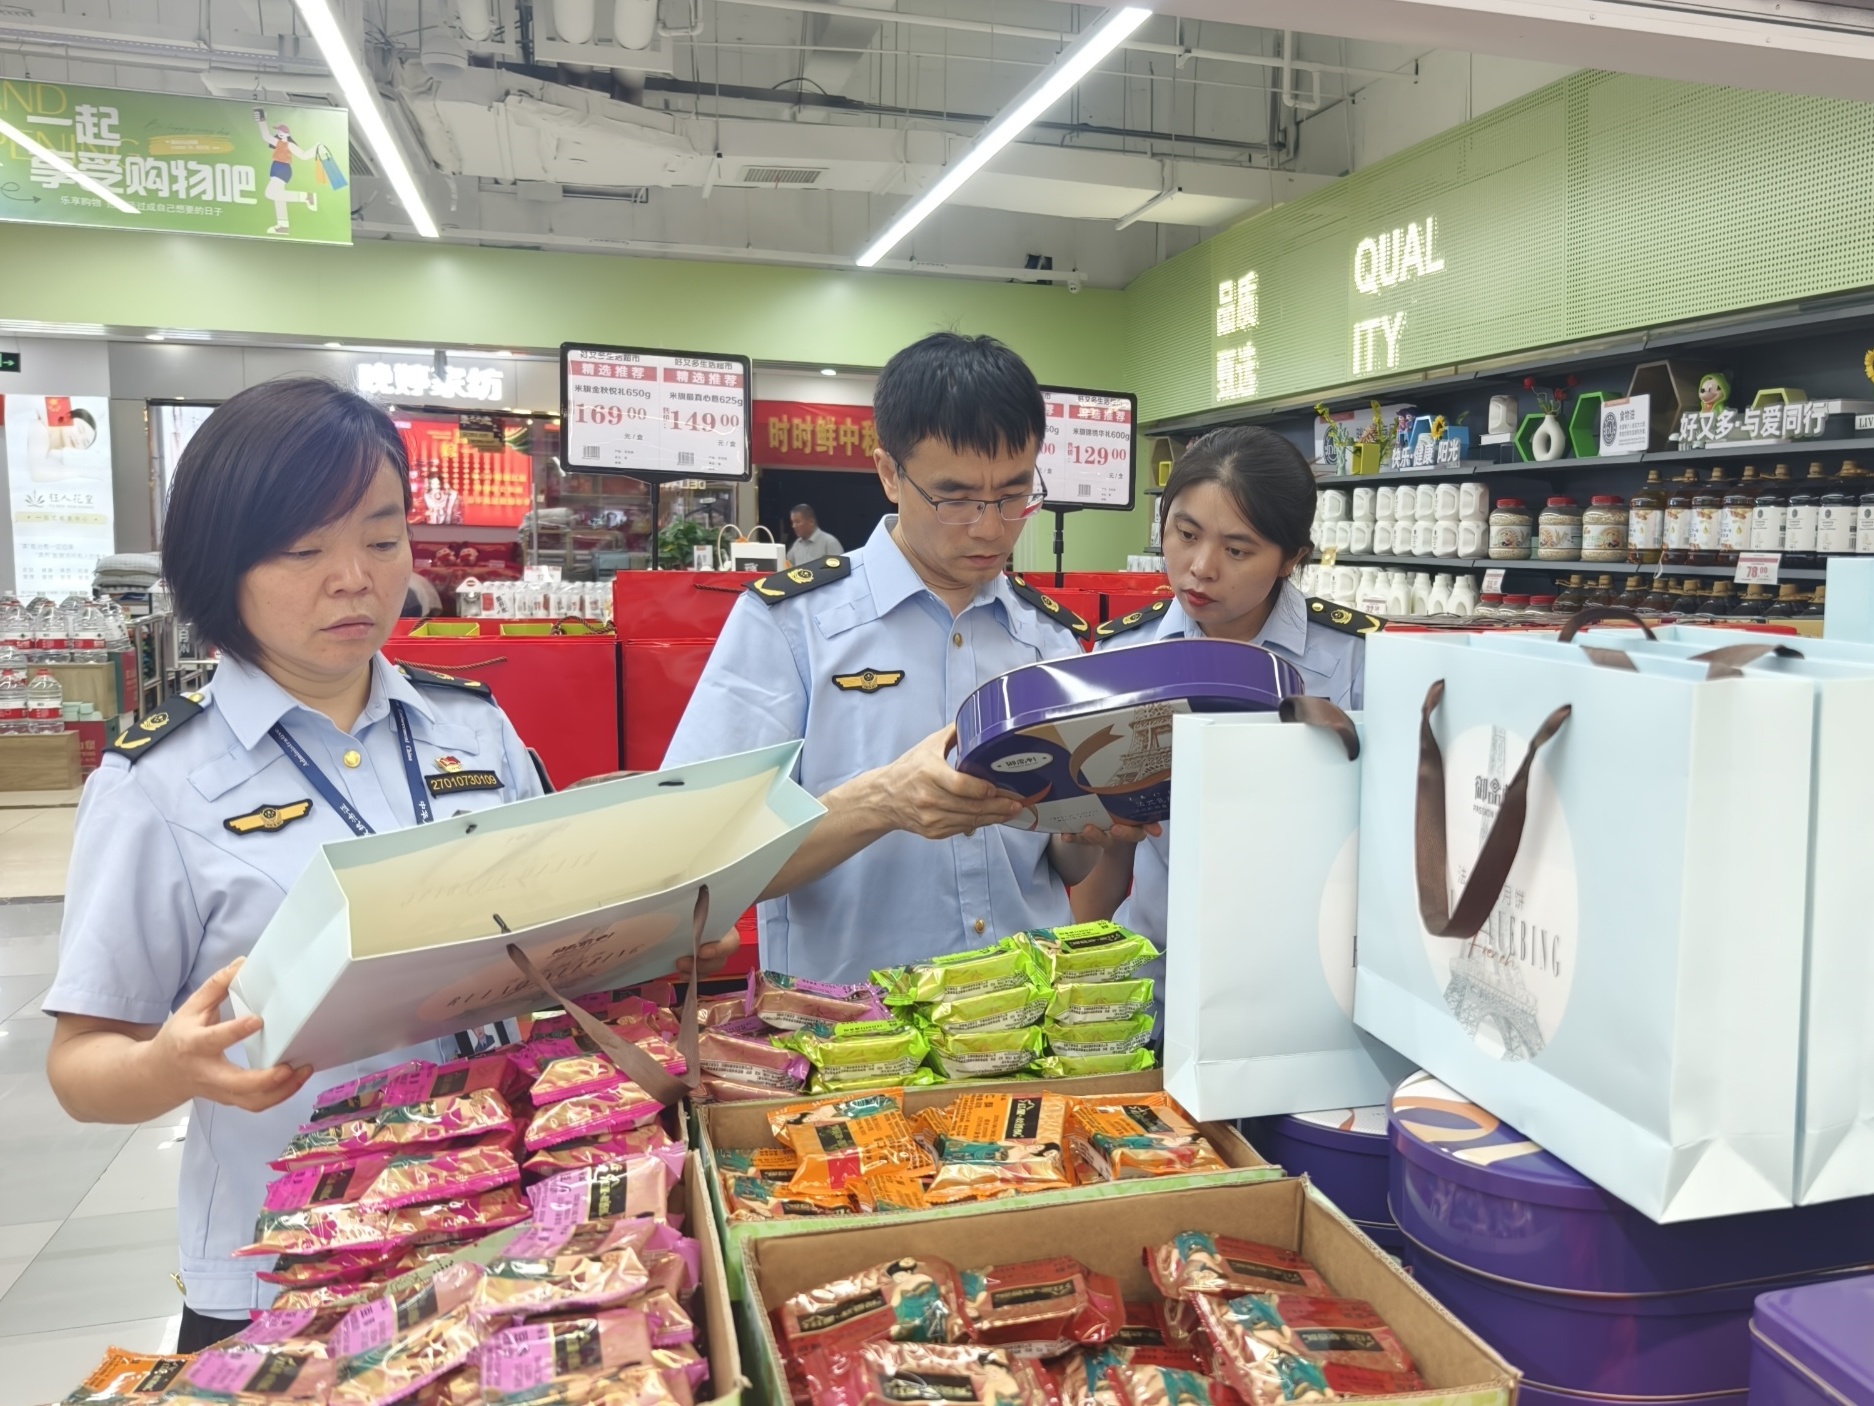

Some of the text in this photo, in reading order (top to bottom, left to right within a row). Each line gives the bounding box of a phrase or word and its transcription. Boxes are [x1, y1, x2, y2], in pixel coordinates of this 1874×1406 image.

[26, 104, 122, 147] 一起
[29, 149, 258, 205] 享受购物吧
[1354, 215, 1446, 295] QUAL
[1352, 311, 1408, 376] ITY
[582, 363, 645, 379] 精选推荐
[676, 370, 737, 387] 精选推荐
[575, 403, 647, 426] 169 00
[670, 410, 740, 432] 149 00
[1679, 400, 1827, 442] 好又多·与爱同行
[768, 414, 879, 458] 时时鲜中秋
[1073, 445, 1127, 466] 129 00
[430, 774, 497, 790] 27010730109
